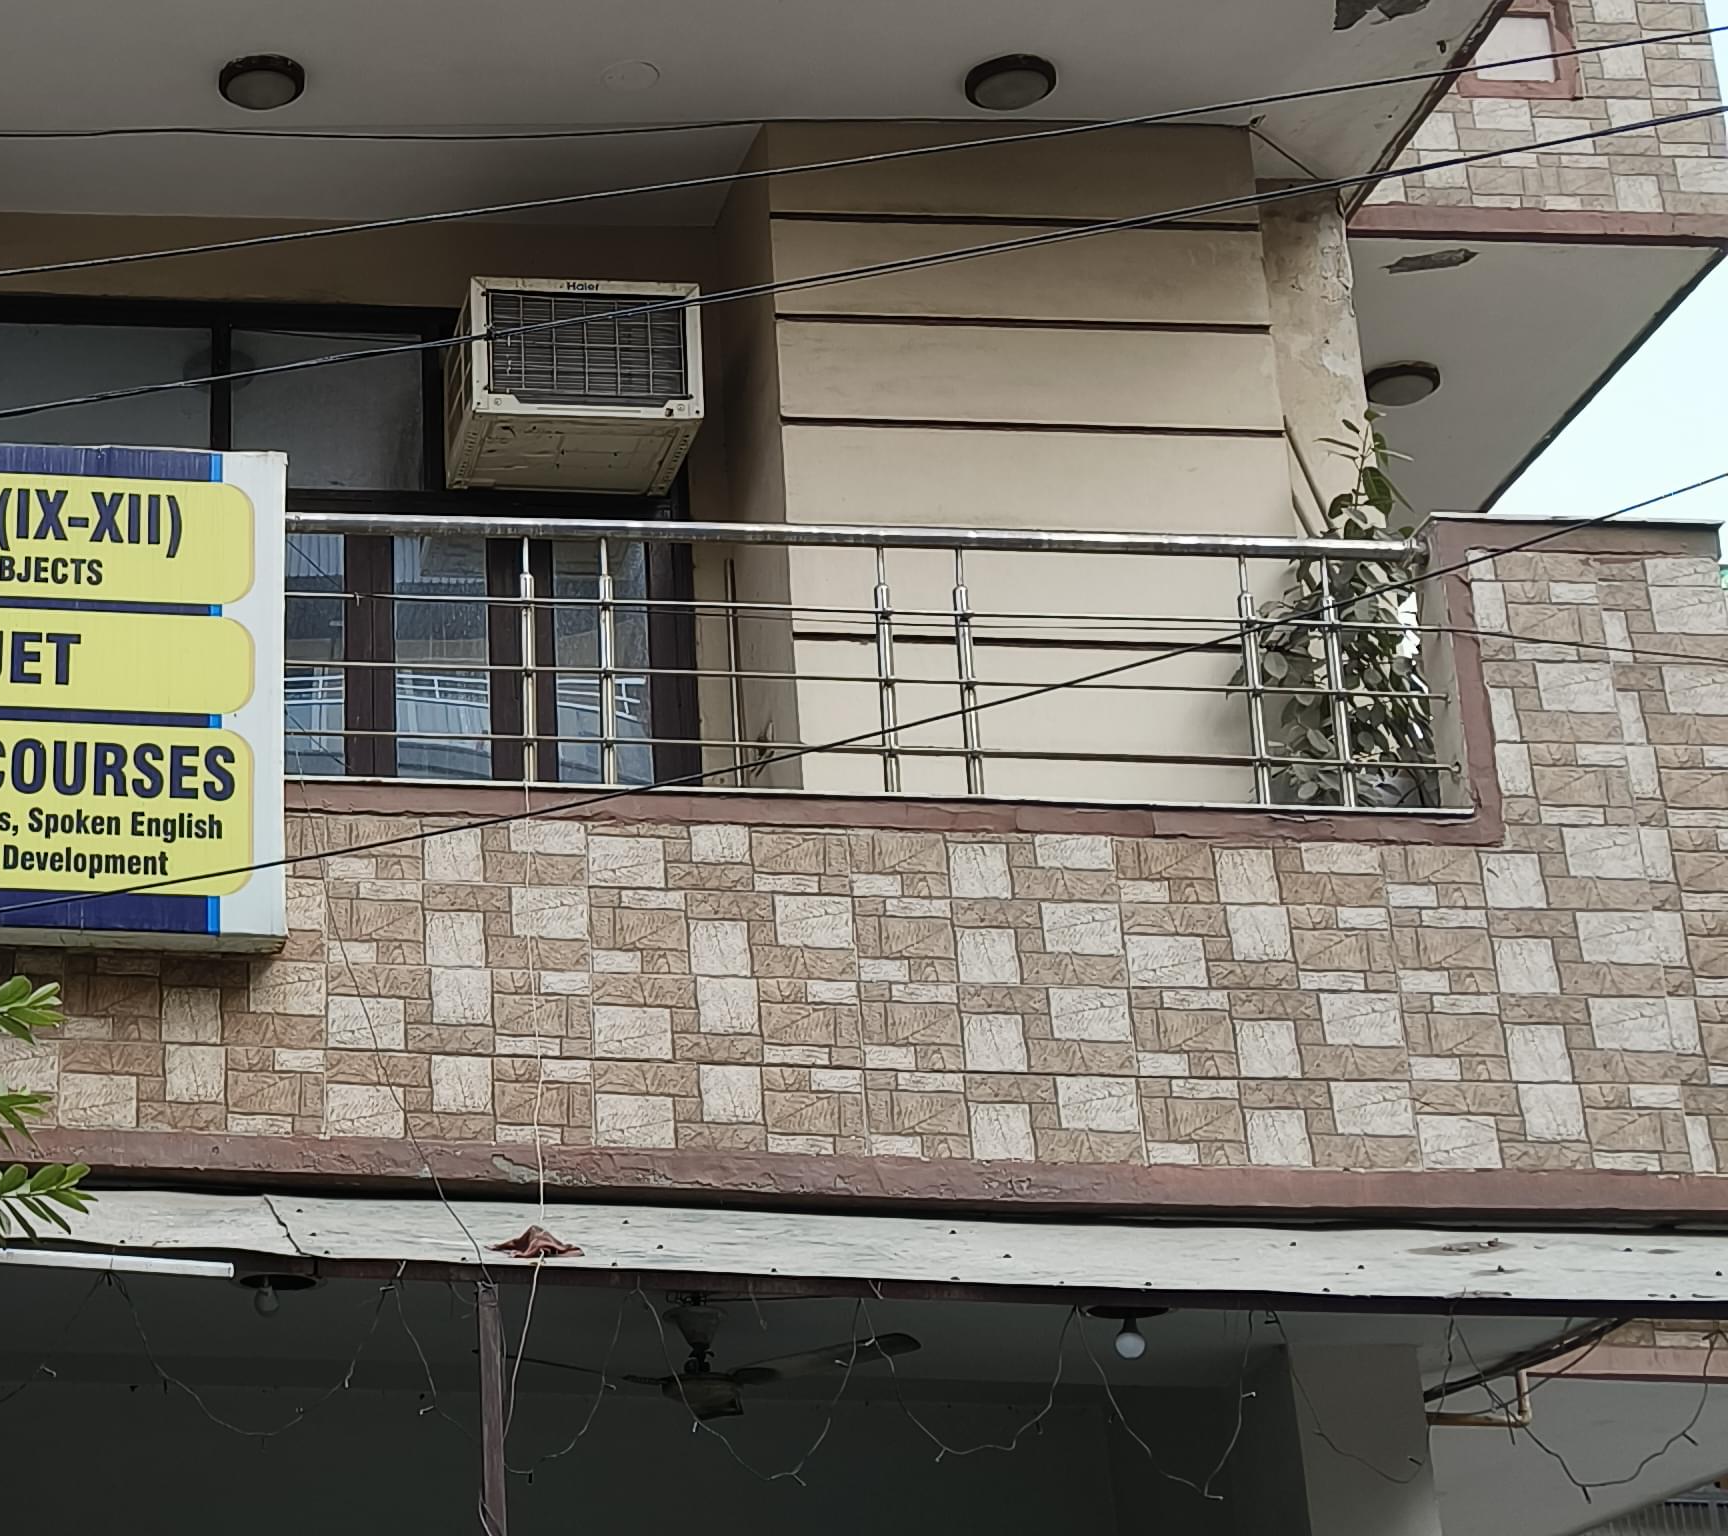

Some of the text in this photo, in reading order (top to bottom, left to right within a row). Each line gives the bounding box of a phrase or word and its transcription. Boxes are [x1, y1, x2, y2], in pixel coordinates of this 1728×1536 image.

[567, 281, 599, 292] Haier
[28, 807, 122, 839] Spoken
[131, 811, 223, 844] English
[3, 846, 169, 880] Development
